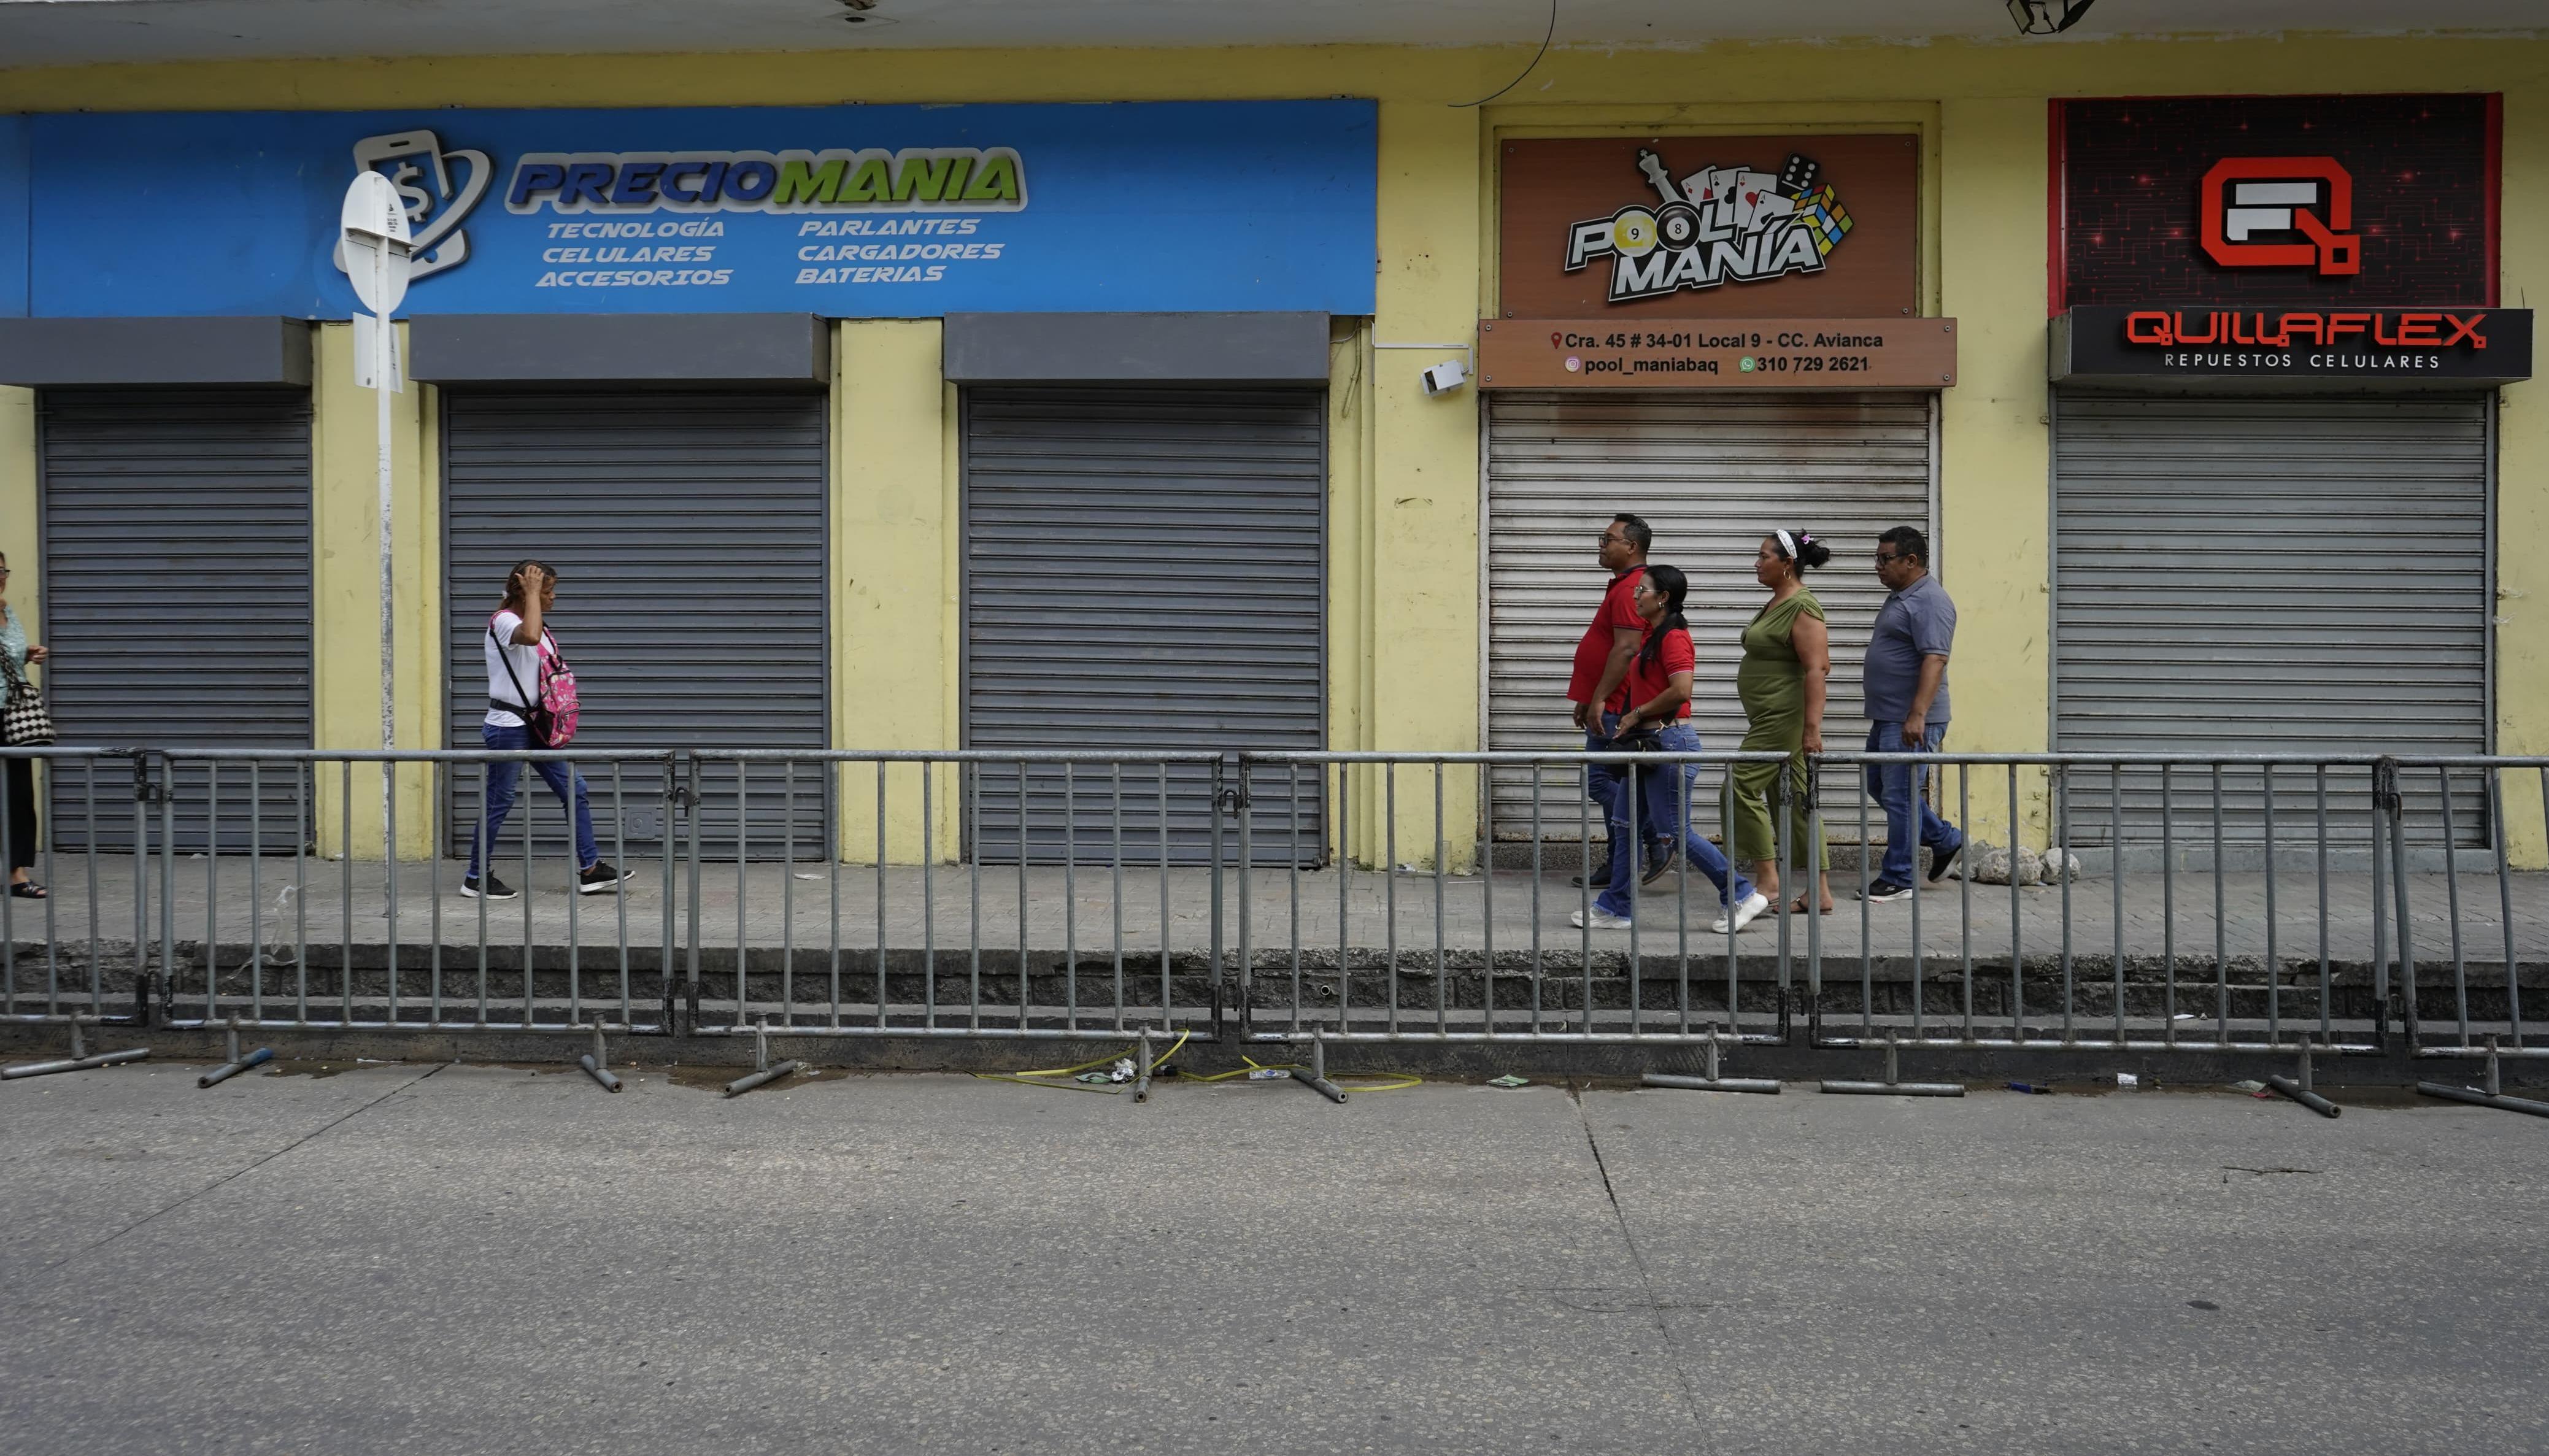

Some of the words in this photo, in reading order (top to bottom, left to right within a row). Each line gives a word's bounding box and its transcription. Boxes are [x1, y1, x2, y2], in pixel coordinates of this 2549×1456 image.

[548, 217, 724, 238] TECNOLOGÍA
[798, 219, 981, 237] PARLANTES
[1630, 228, 1640, 240] 9
[1674, 223, 1682, 234] 8
[542, 246, 716, 263] CELULARES
[798, 244, 1006, 261] CARGADORES
[534, 269, 734, 287] ACCESORIOS
[795, 266, 947, 283] BATERIAS
[2127, 311, 2487, 348] QUILLAFLEX
[1565, 333, 1600, 348] Cra.
[1605, 333, 1625, 348] 45
[1630, 333, 1641, 348] #
[1646, 333, 1691, 348] 34-01
[1699, 333, 1745, 348] Local
[1751, 333, 1760, 347] 9
[1778, 333, 1808, 347] CC.
[1813, 333, 1883, 347] Avianca
[1586, 357, 1718, 375] pool_maniabaq
[1757, 357, 1787, 371] 310
[1794, 357, 1823, 371] 729
[1829, 356, 1867, 371] 2621
[2165, 354, 2291, 366] REPUESTOS
[2310, 355, 2439, 368] CELULARES
